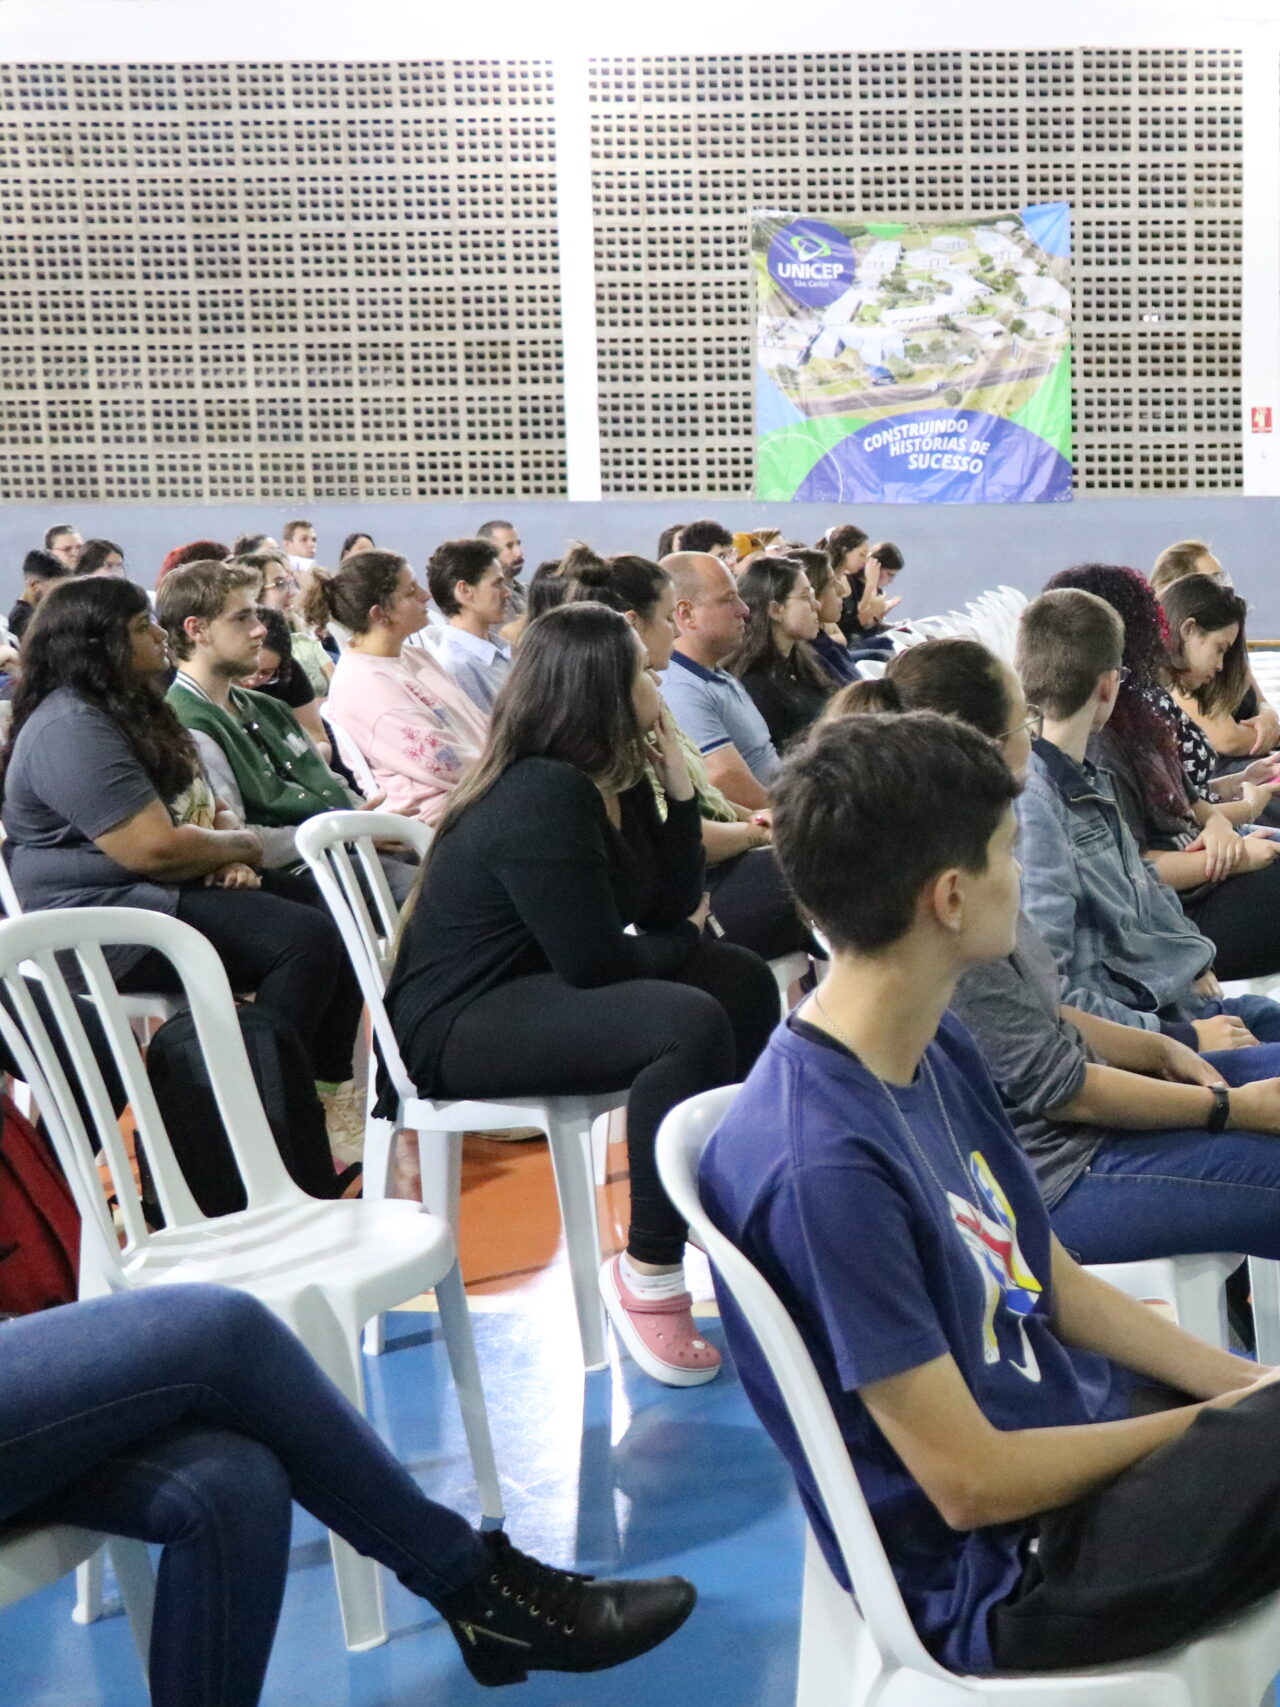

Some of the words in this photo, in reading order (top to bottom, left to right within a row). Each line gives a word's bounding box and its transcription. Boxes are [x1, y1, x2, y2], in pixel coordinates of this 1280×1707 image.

[778, 262, 844, 279] UNICEP
[863, 418, 969, 452] CONSTRUINDO
[889, 432, 968, 457] HISTÓRIAS
[969, 440, 991, 456] DE
[907, 452, 984, 474] SUCESSO
